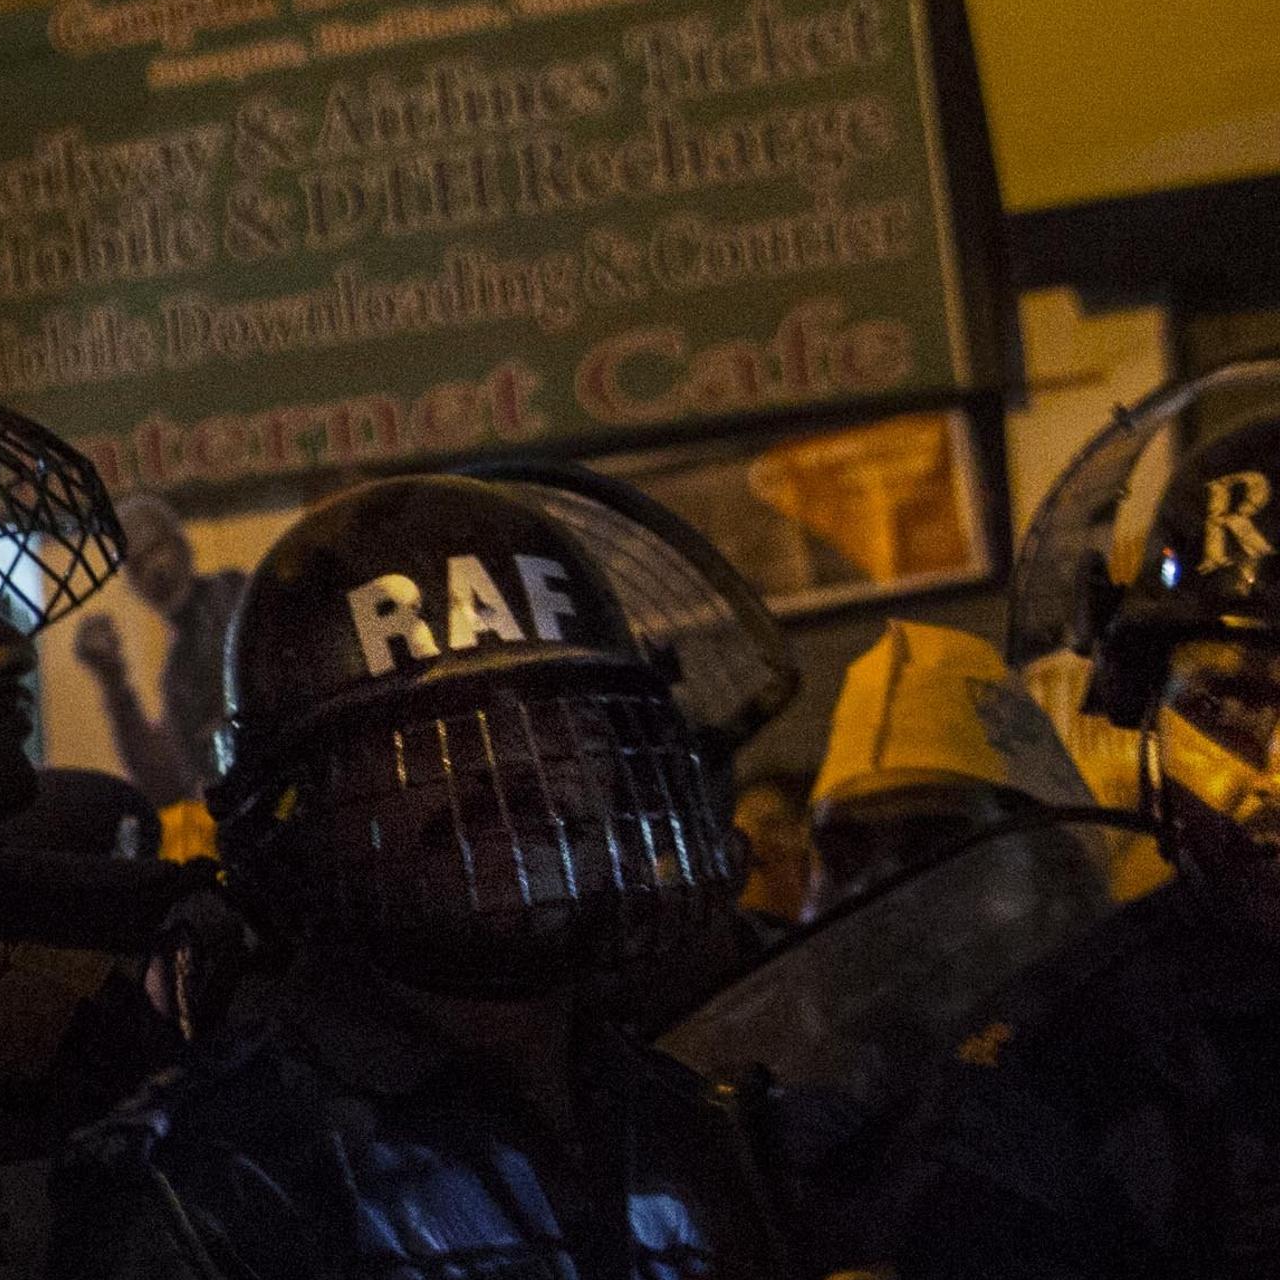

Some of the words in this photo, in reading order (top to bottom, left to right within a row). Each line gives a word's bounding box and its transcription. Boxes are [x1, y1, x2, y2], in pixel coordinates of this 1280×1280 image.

[224, 175, 302, 262] &
[302, 135, 512, 252] DTH
[514, 95, 895, 215] Recharge
[235, 94, 308, 170] &
[310, 55, 620, 160] Airlines
[158, 245, 578, 370] Downloading
[582, 227, 648, 303] &
[648, 196, 916, 295] Courier
[70, 360, 546, 488] nternet
[572, 294, 916, 422] Cafe
[347, 553, 579, 678] RAF
